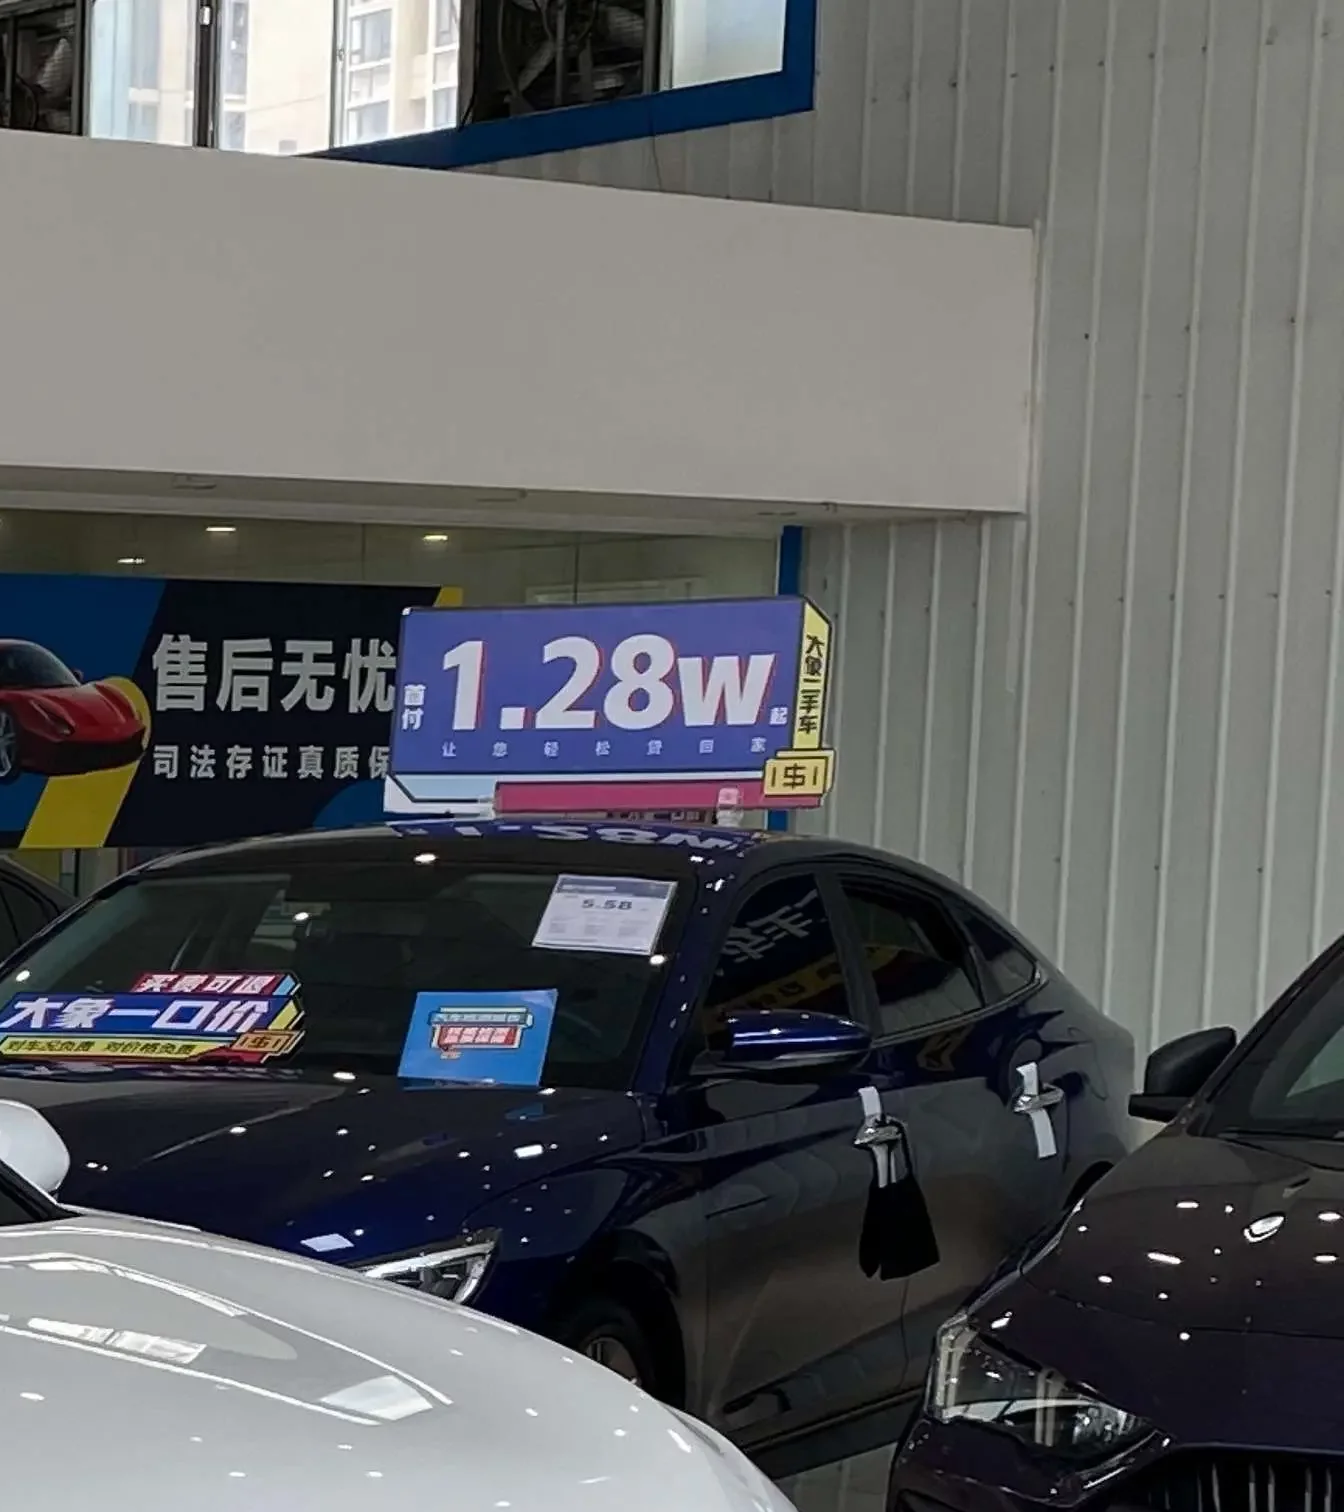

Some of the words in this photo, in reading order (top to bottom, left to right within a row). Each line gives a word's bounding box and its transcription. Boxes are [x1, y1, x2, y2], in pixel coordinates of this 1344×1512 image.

[152, 633, 397, 713] 售后无忧
[797, 634, 825, 735] 大象二手车
[402, 684, 426, 730] 首付
[769, 707, 789, 726] 起
[152, 745, 391, 779] 司法存证真质保
[442, 737, 767, 758] 让您轻松贷回家
